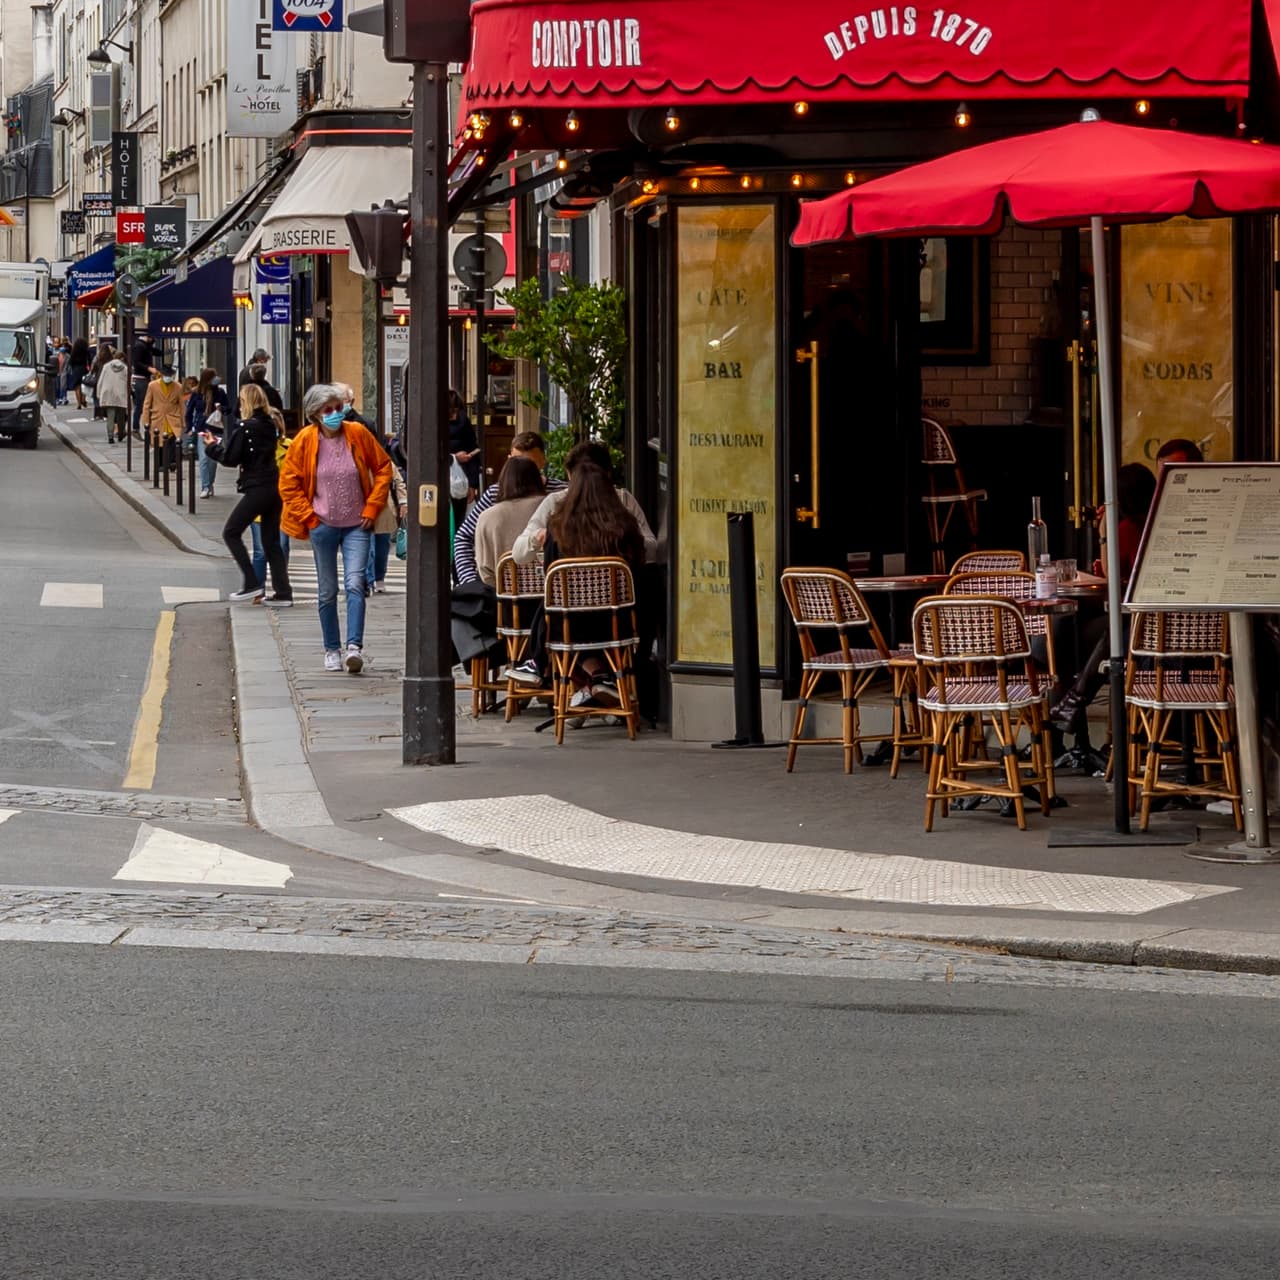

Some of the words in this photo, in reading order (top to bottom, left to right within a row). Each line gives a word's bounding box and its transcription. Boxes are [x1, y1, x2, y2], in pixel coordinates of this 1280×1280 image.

[531, 18, 642, 68] COMPTOIR
[823, 6, 918, 62] DEPUIS
[929, 8, 994, 57] 1870
[249, 101, 281, 110] HOTEL
[120, 139, 130, 200] HÔTEL
[122, 221, 146, 234] SFR
[272, 229, 337, 248] BRASSERIE
[71, 270, 116, 279] Restaurant
[703, 361, 743, 380] BAR
[1142, 361, 1214, 382] SODAS
[689, 432, 765, 448] RESTAURANT
[689, 497, 728, 513] CUISINE
